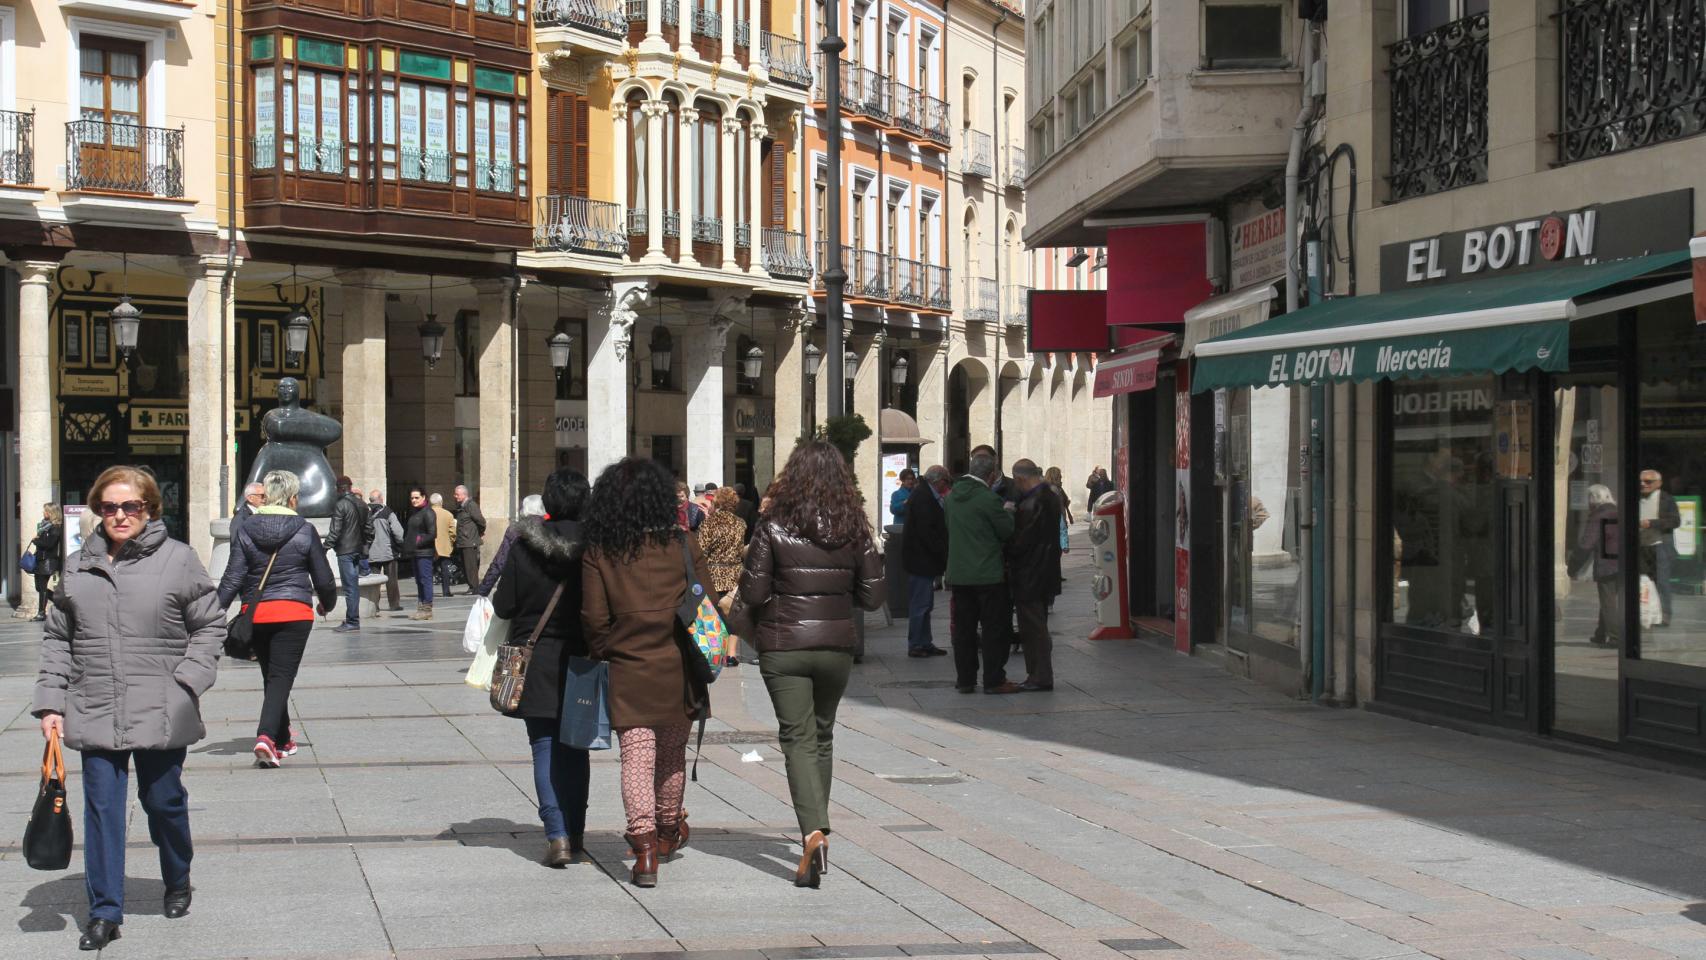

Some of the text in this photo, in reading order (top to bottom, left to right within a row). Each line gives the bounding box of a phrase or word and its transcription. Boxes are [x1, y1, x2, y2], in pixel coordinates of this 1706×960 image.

[1243, 207, 1287, 250] HERRER
[1406, 210, 1596, 282] EL BOTON
[1269, 340, 1451, 382] EL BOTON Mercería
